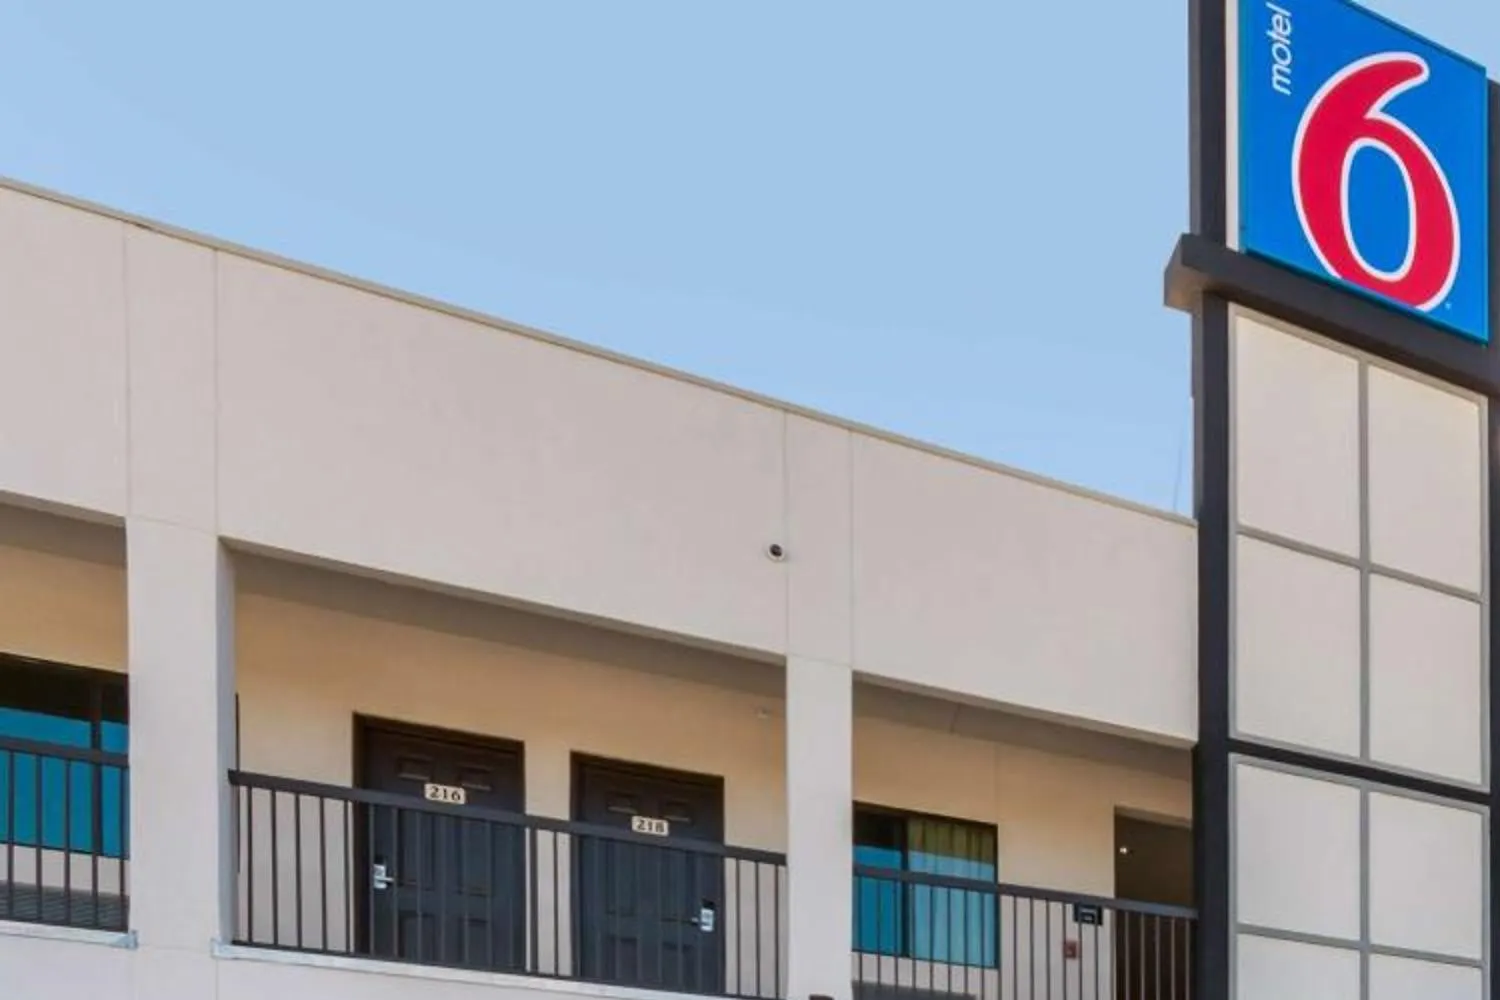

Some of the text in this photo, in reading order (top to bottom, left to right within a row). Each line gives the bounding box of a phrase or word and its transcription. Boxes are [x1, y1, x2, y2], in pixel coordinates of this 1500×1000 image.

[1265, 1, 1292, 96] motel
[1291, 51, 1461, 313] 6
[428, 785, 462, 802] 216
